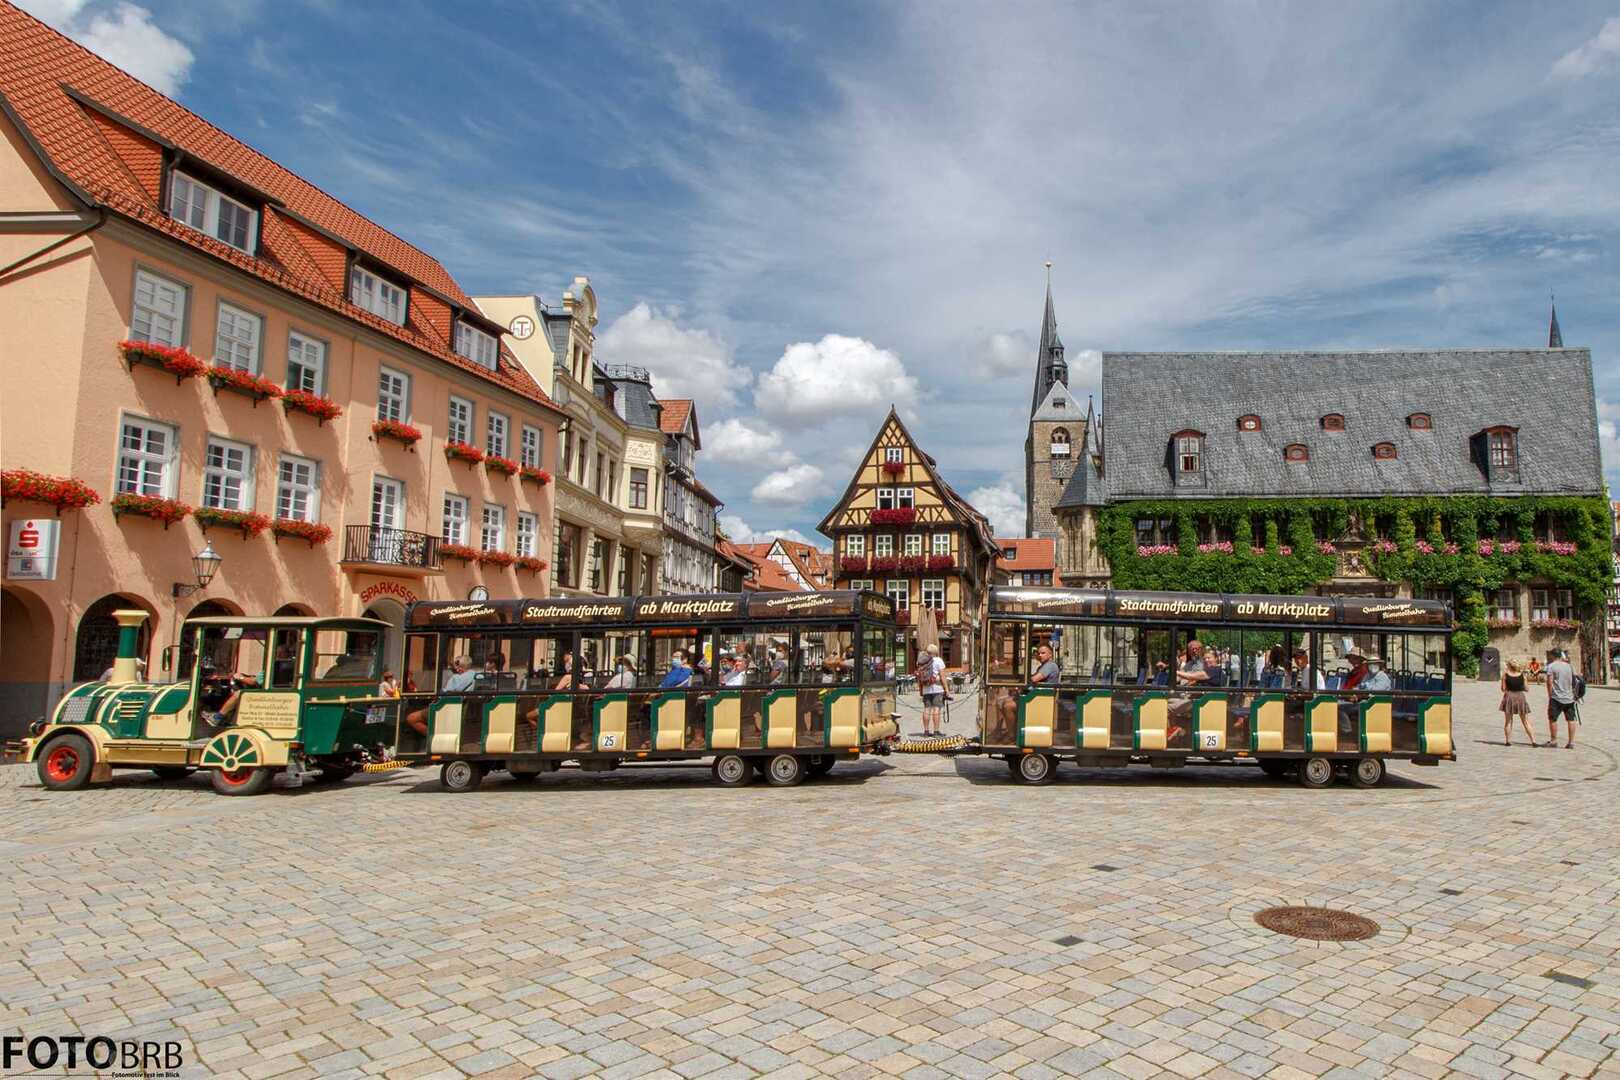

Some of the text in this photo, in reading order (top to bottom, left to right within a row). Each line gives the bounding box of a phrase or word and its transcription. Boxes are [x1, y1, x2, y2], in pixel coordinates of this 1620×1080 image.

[640, 599, 734, 615] ab Marktplatz
[766, 594, 821, 607] Quedlinburger
[1120, 599, 1218, 614] Stadtrundfahrten
[526, 605, 622, 619] Stadtrundfahrten
[1237, 601, 1330, 618] ab Marktplatz
[1362, 603, 1411, 614] Quedlinburger
[604, 735, 614, 746] 25
[1206, 735, 1216, 746] 25
